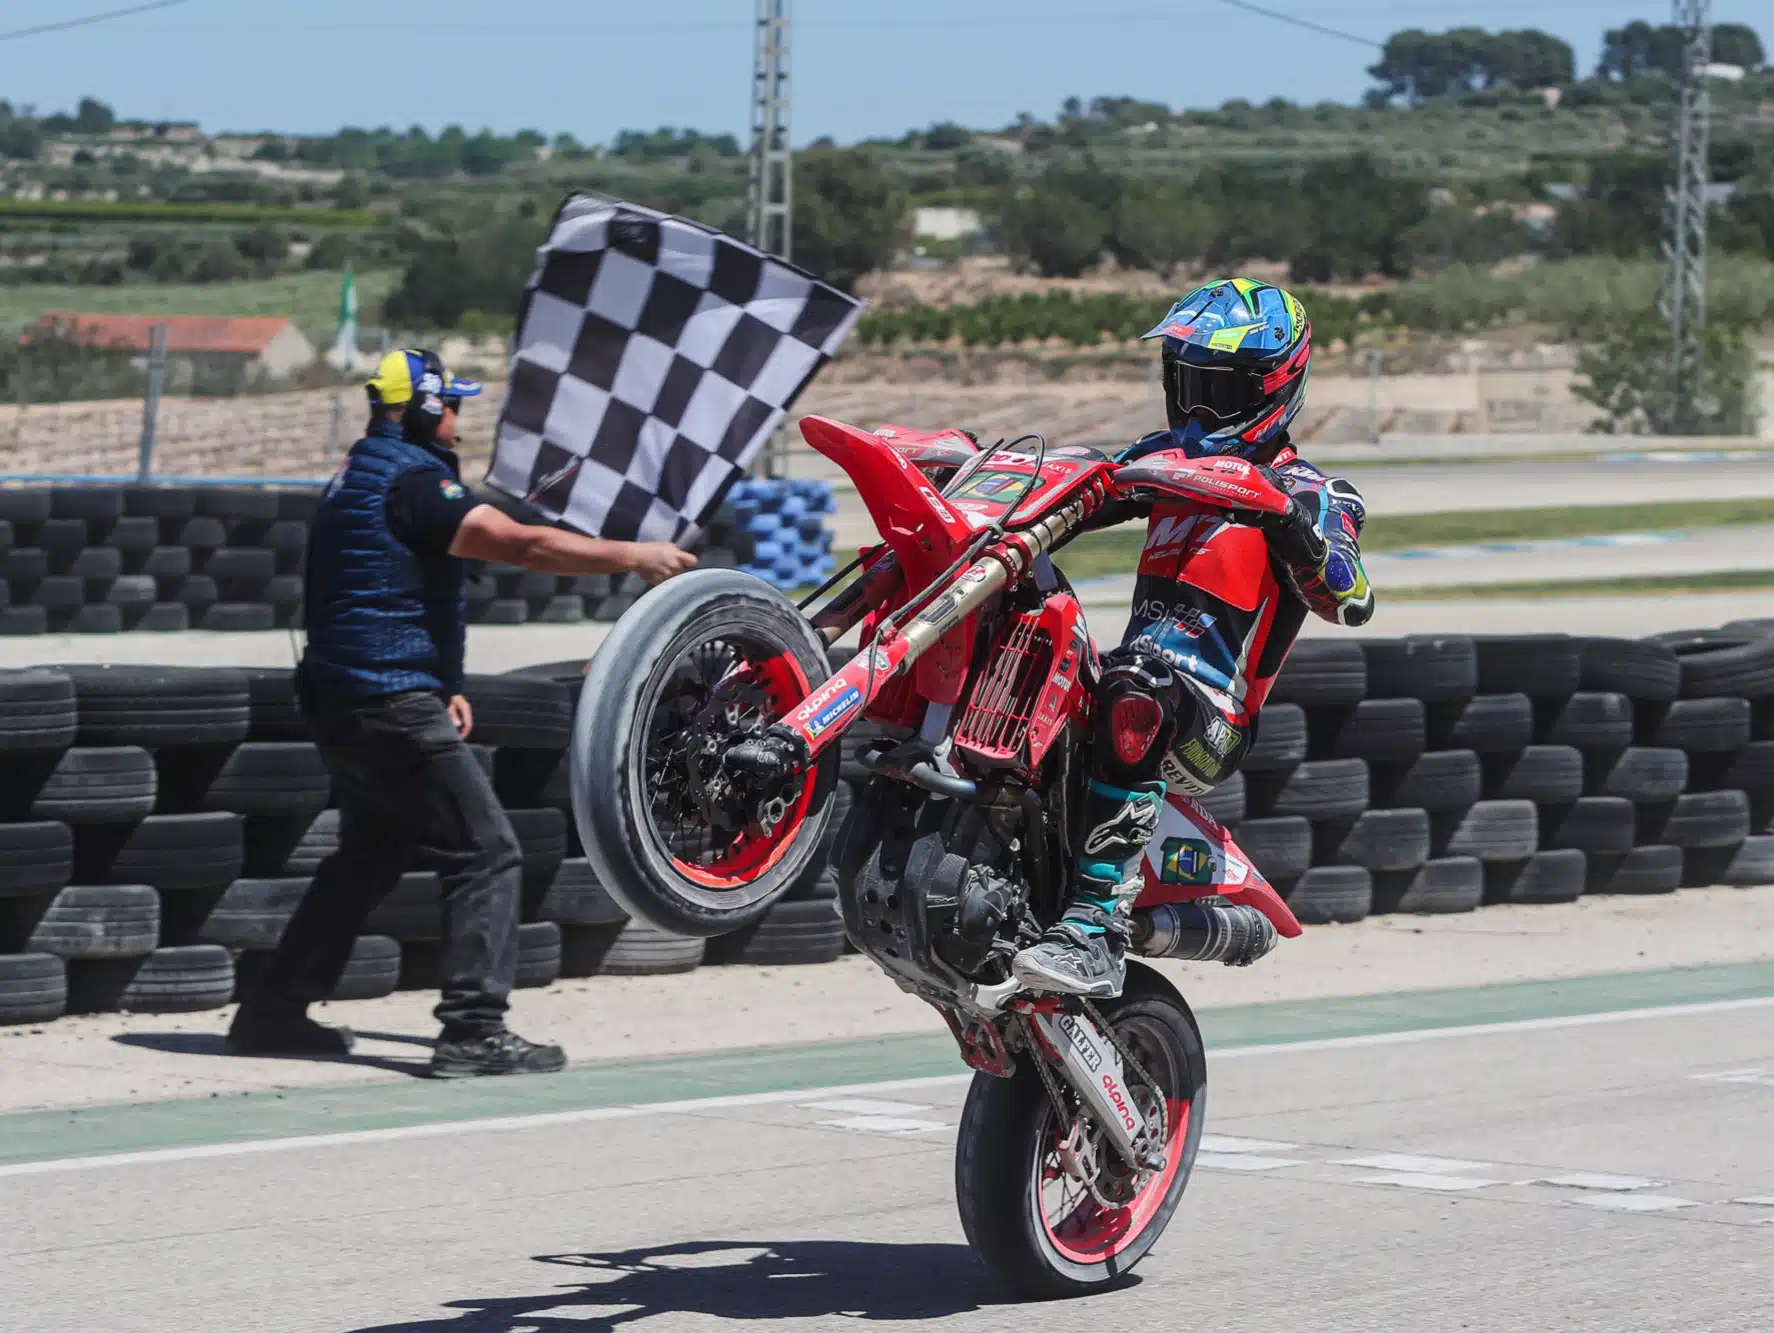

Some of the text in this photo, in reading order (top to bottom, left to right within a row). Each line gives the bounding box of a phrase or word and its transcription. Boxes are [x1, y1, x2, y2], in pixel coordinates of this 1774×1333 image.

[1193, 474, 1261, 499] POLISPORT
[822, 690, 860, 725] MICHELIN
[1060, 1014, 1102, 1072] GALFER
[1101, 1074, 1136, 1131] alpina
